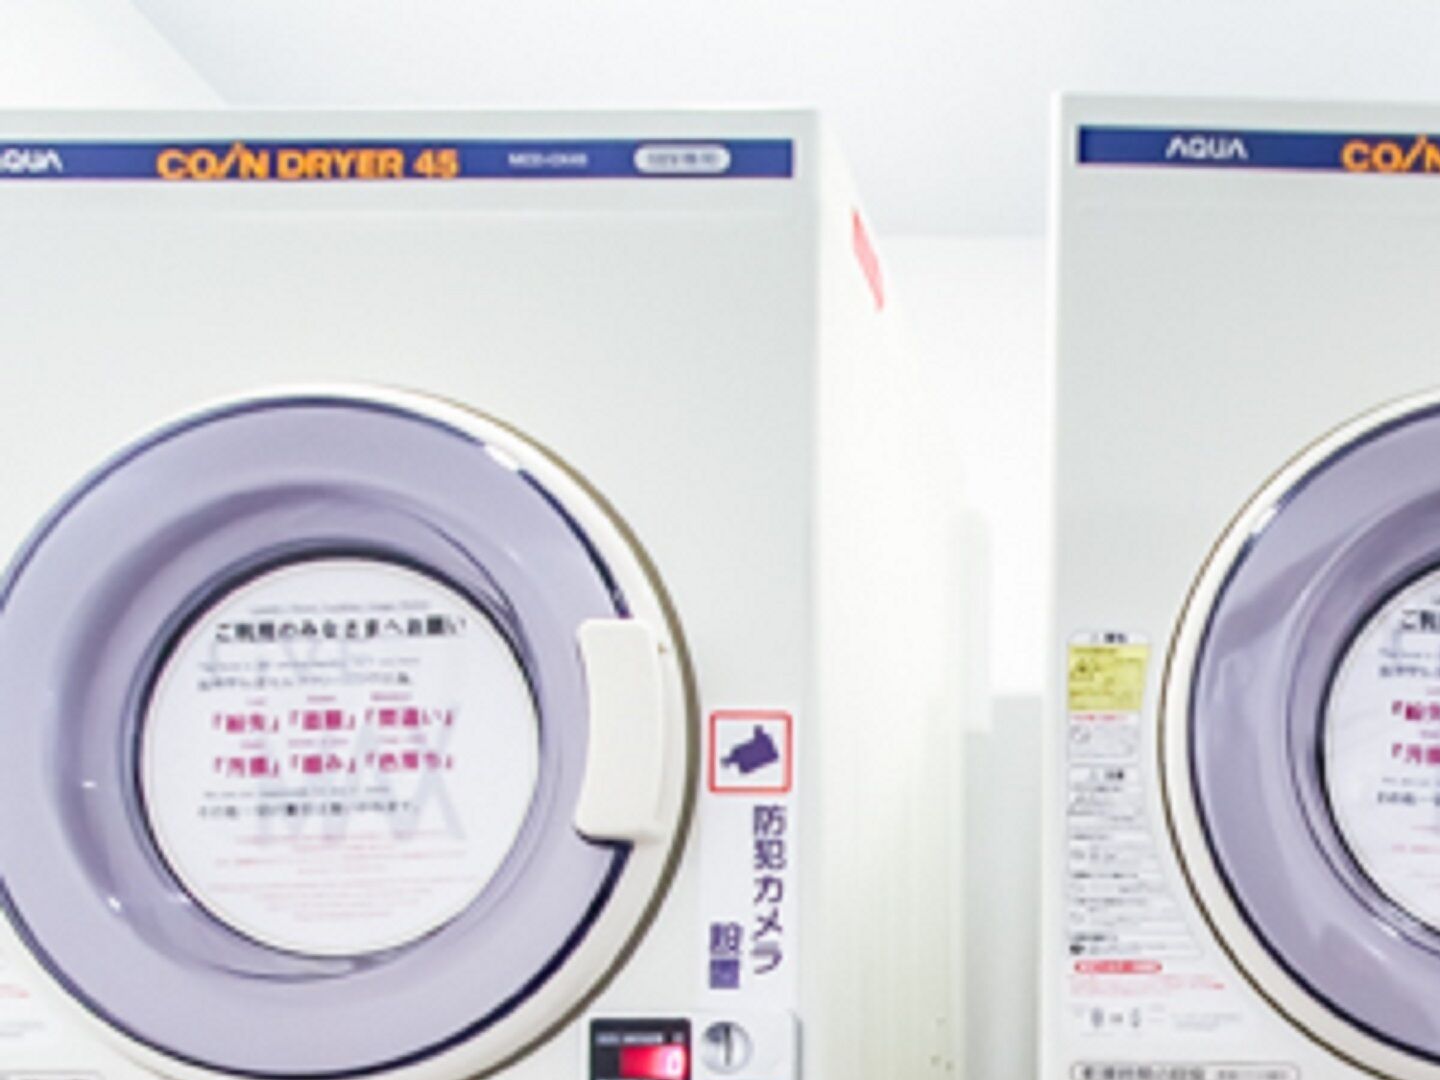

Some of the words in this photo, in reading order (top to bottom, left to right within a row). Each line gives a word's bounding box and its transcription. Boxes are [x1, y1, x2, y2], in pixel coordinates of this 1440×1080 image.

[157, 141, 268, 179] COIN
[277, 150, 403, 179] DRYER
[413, 149, 459, 179] 45
[1166, 137, 1247, 159] AQUA
[753, 804, 787, 975] 防犯カメラ
